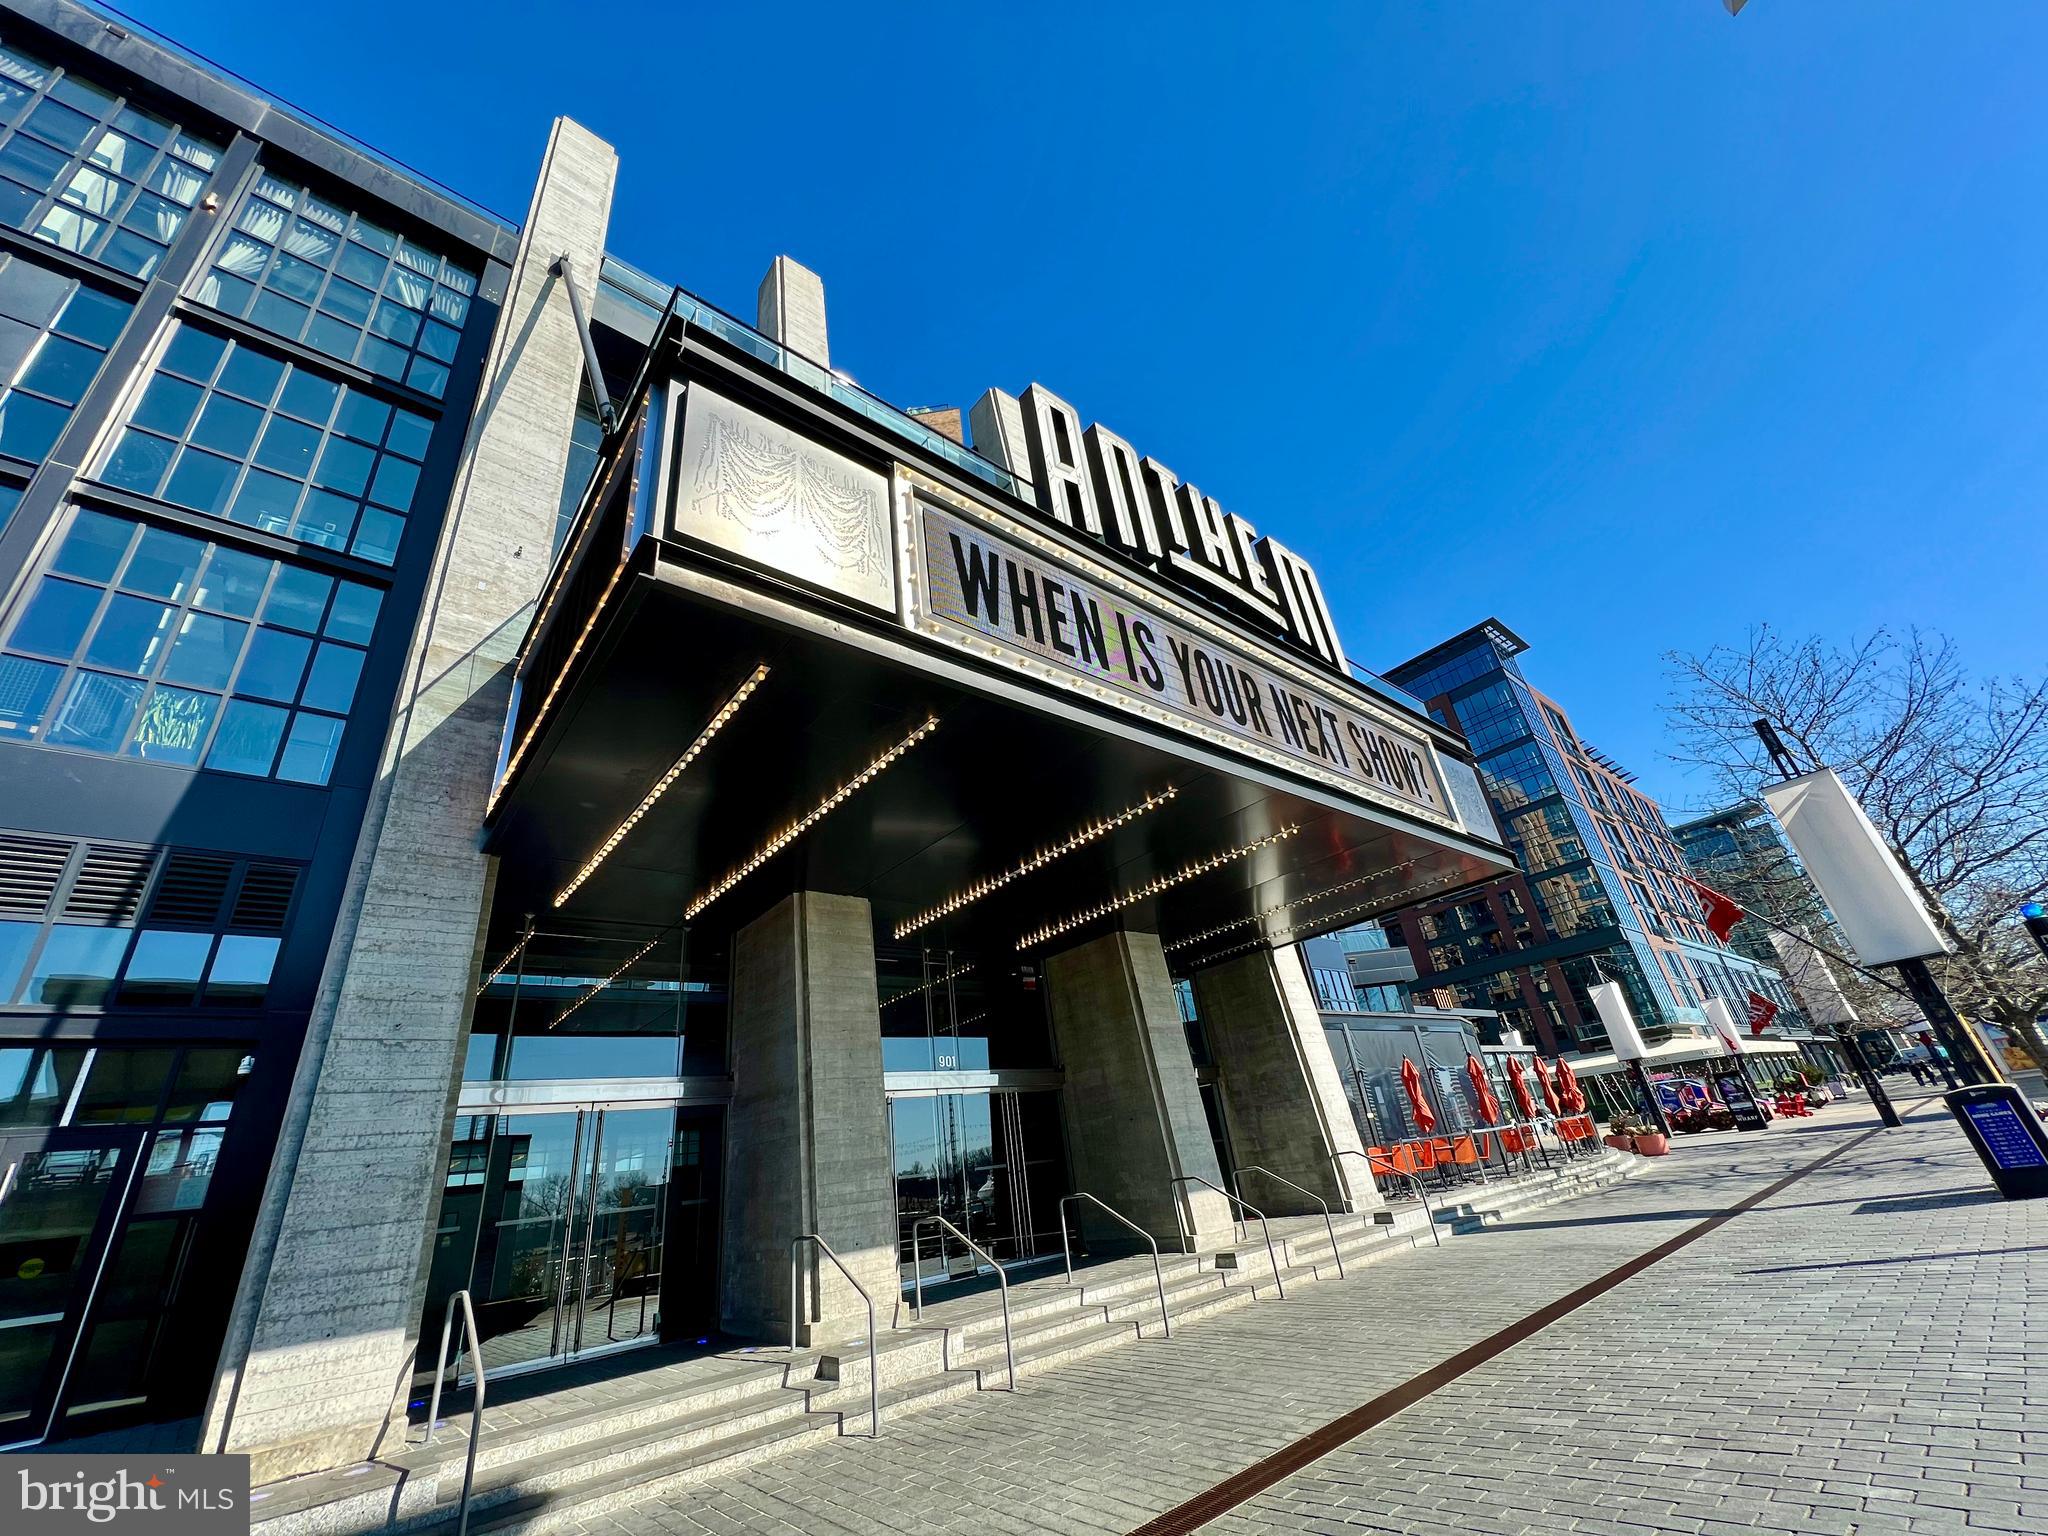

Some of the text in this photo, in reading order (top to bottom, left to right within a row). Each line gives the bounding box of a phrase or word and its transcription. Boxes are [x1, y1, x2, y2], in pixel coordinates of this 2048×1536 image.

[1018, 382, 1352, 676] ANTHEM
[949, 531, 1434, 802] WHEN IS YOUR NEXT SHOW?
[938, 1055, 956, 1067] 901
